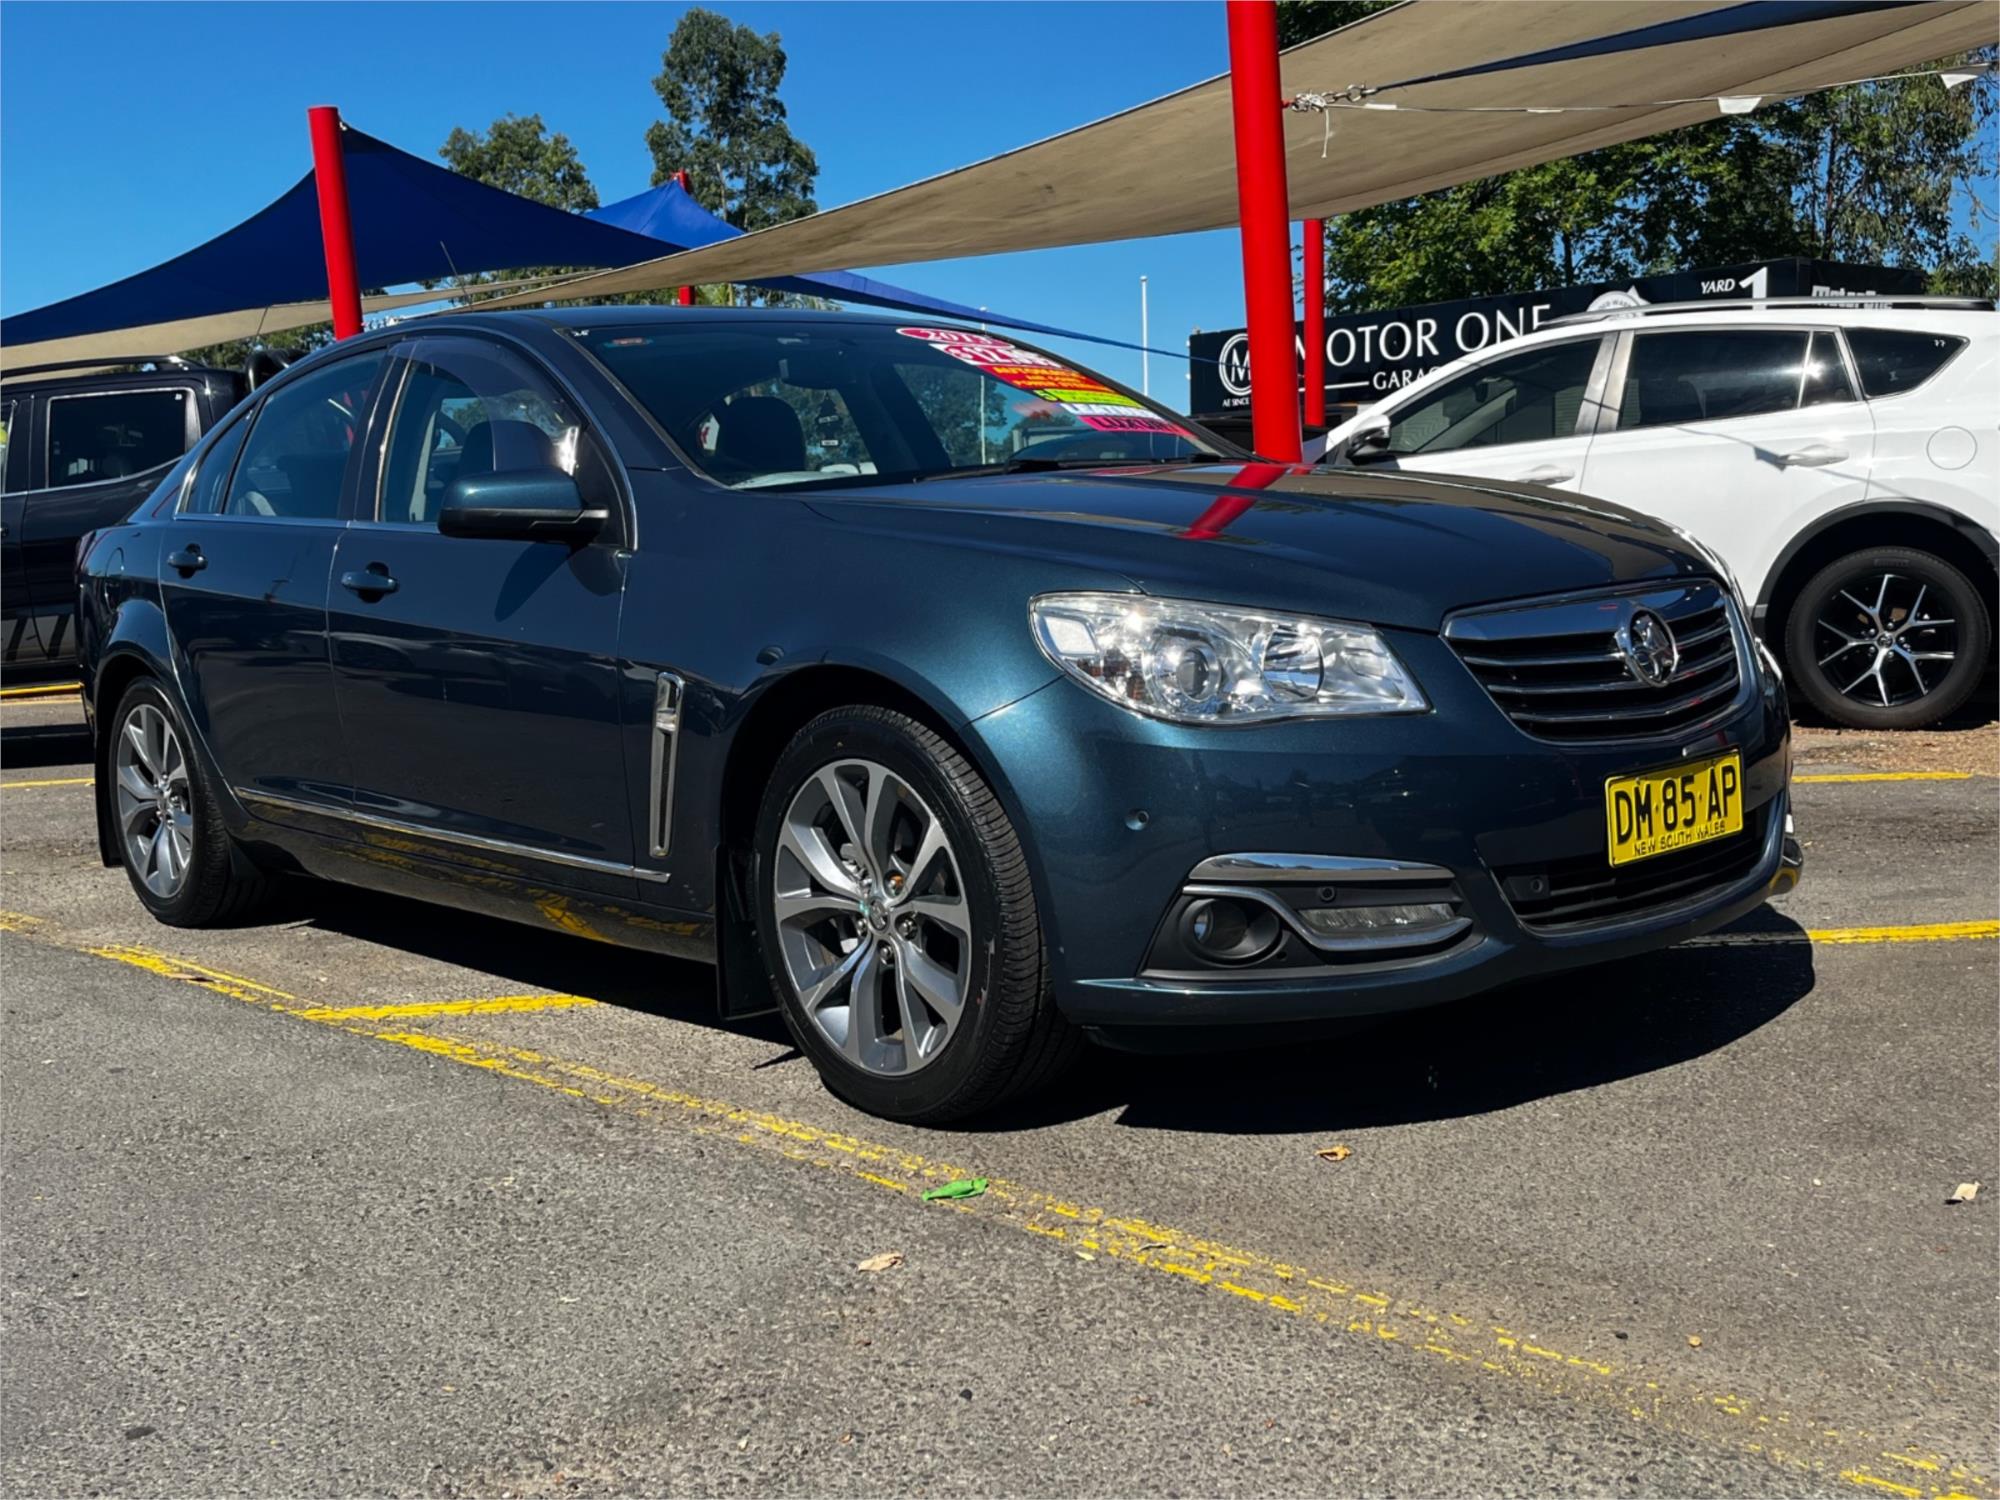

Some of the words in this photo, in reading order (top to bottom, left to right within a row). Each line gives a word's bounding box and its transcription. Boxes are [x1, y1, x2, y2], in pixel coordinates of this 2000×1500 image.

[1701, 278, 1735, 295] YARD
[1738, 266, 1768, 307] 1
[1296, 318, 1439, 367] OTOR
[1373, 365, 1442, 390] GARA
[1634, 840, 1656, 856] NEW
[1660, 831, 1692, 850] SOUTH
[1697, 820, 1726, 840] WALES
